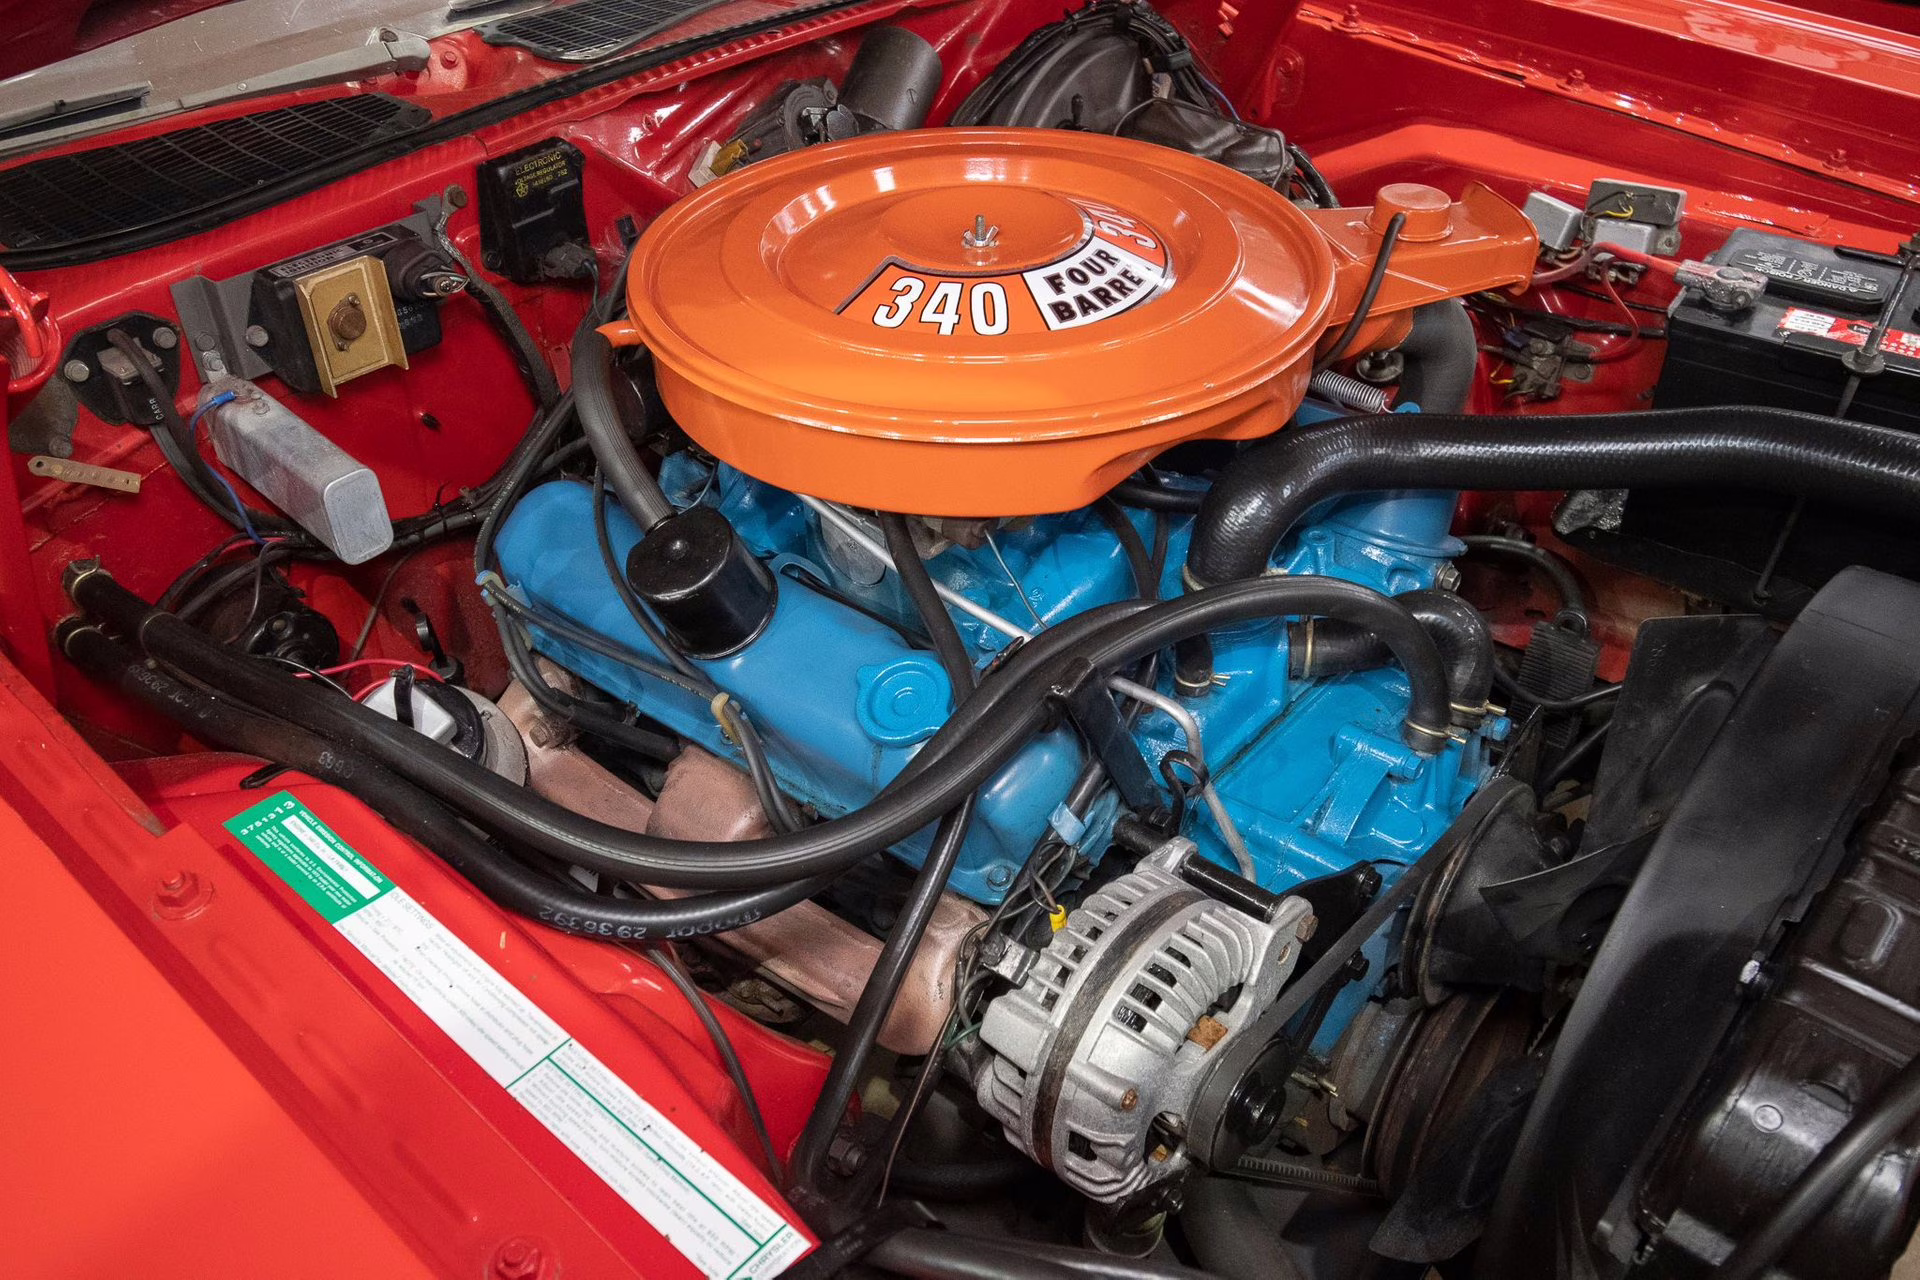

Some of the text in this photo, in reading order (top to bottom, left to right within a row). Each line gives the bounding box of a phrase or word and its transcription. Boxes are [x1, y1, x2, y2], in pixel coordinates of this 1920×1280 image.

[514, 151, 561, 175] ELECTRONIC
[1043, 248, 1121, 296] FOUR
[1048, 264, 1152, 324] BARRE
[872, 275, 1009, 336] 340
[240, 800, 295, 836] 3751313
[298, 810, 317, 826] VEHICLE
[334, 841, 355, 859] CONTROL
[352, 857, 383, 884] INFORMATION
[538, 904, 648, 939] 2936392
[747, 1230, 796, 1275] CHRYSLER
